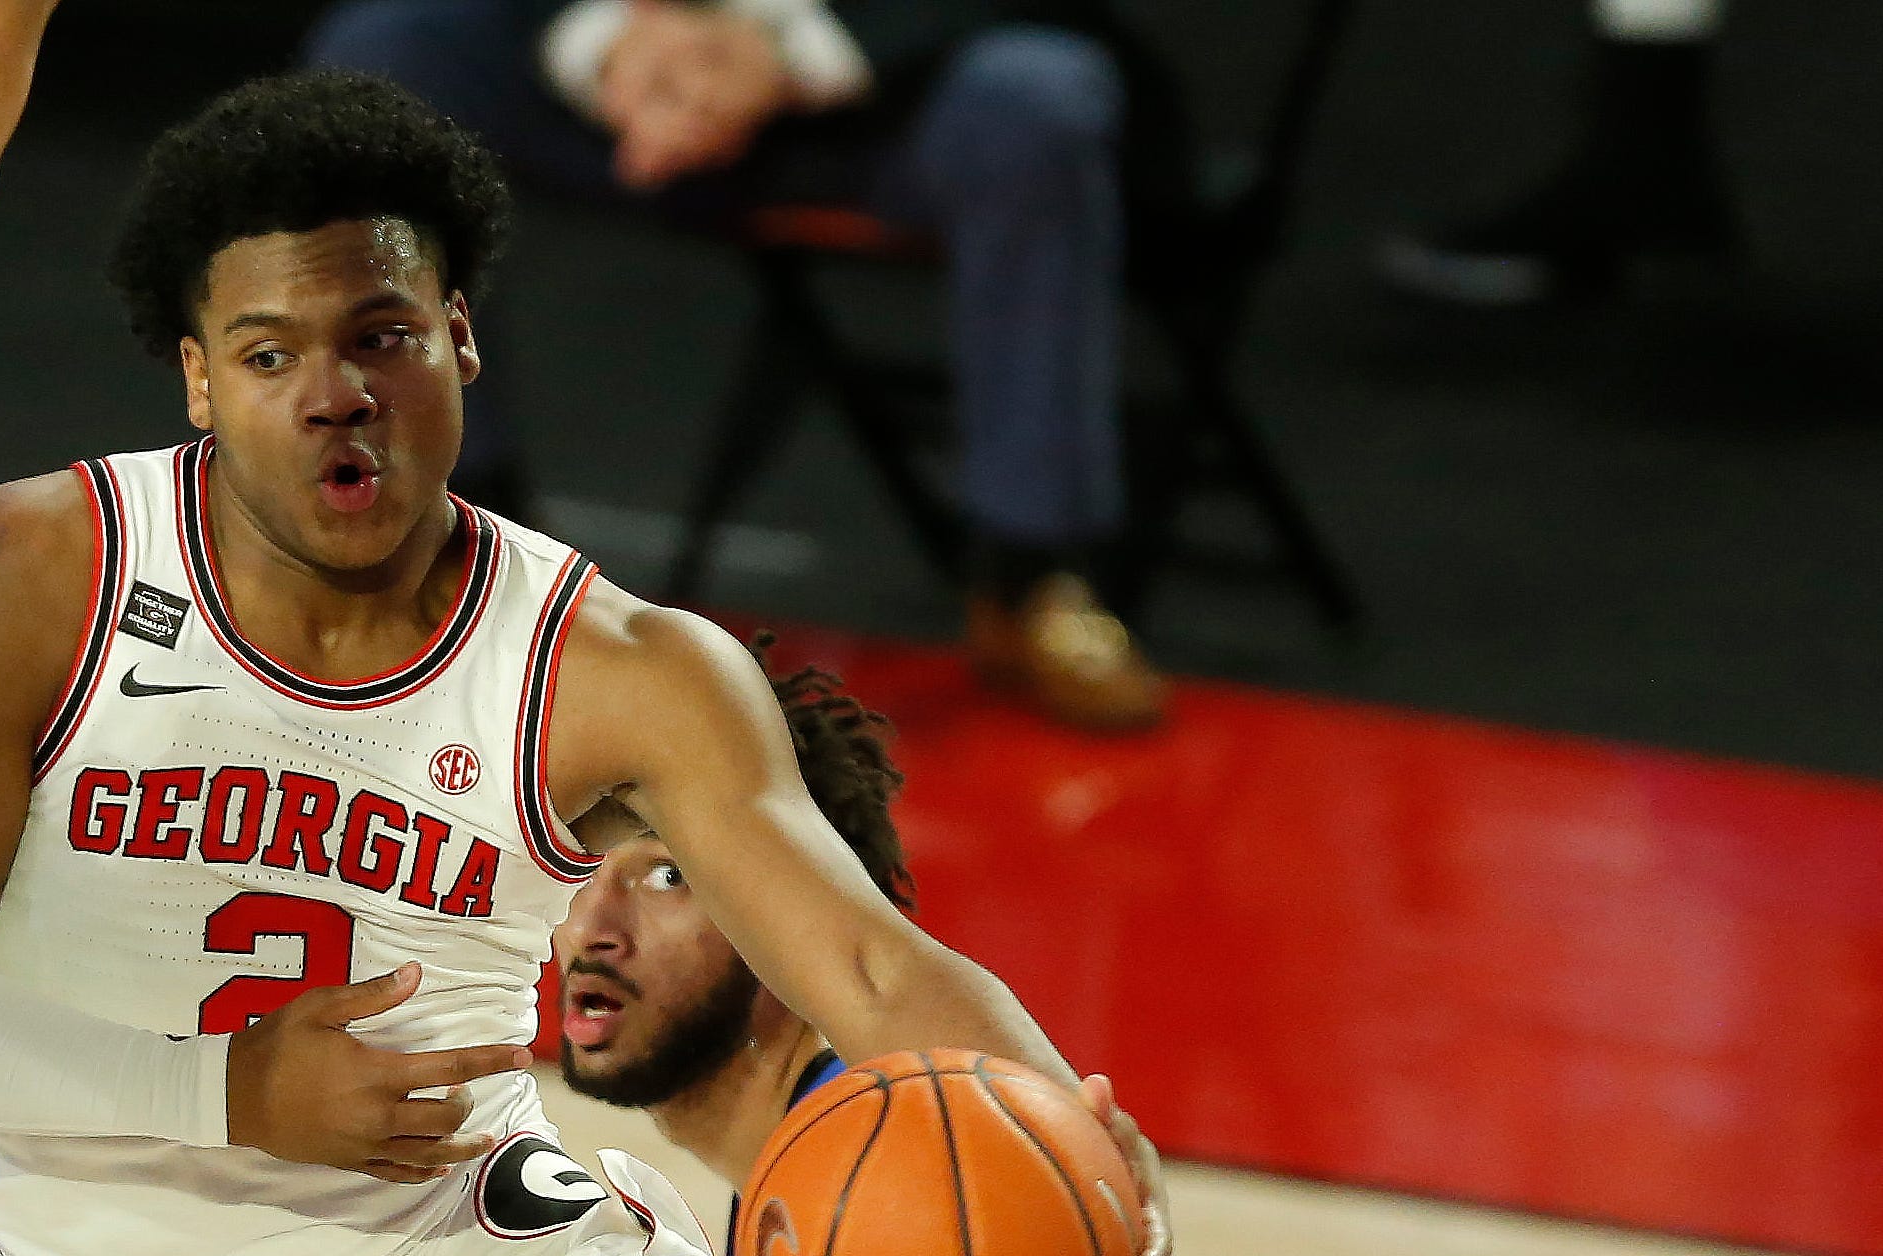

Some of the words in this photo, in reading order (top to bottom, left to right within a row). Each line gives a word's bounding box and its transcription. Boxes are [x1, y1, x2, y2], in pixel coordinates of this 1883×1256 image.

[127, 612, 175, 636] EQUALITY
[433, 749, 477, 790] SEC
[68, 766, 503, 918] GEORGIA
[200, 891, 355, 1036] 2
